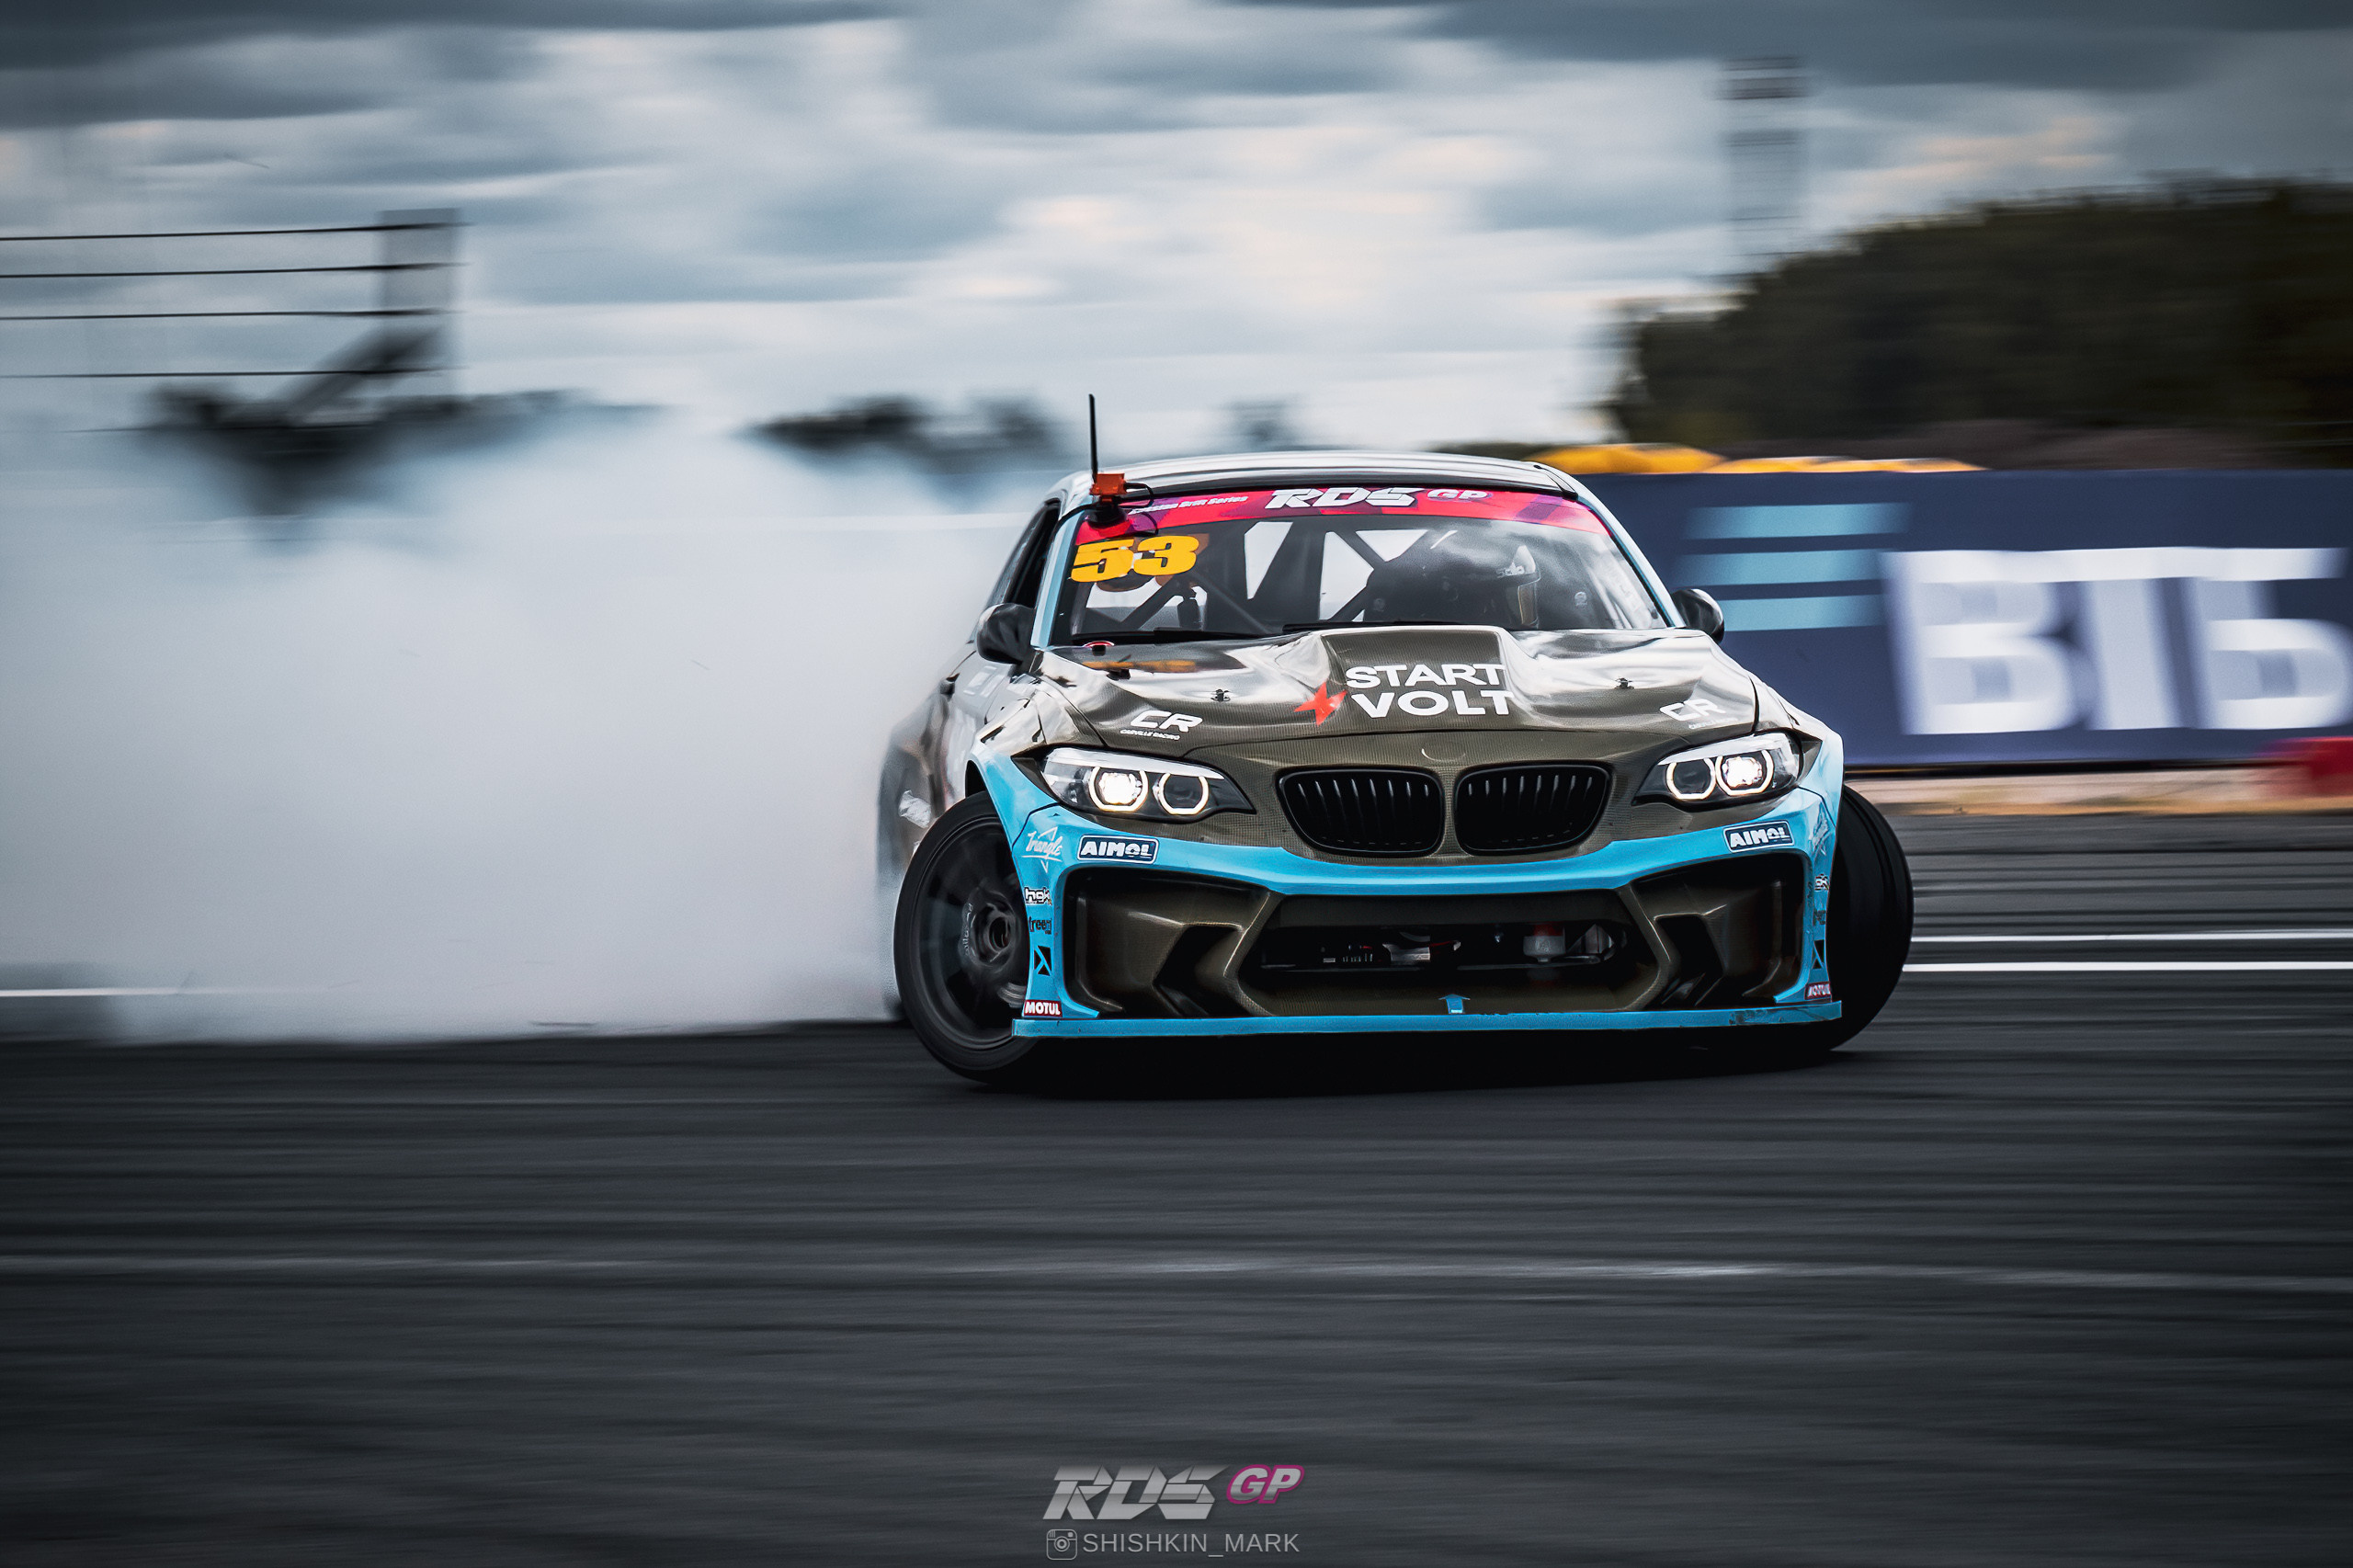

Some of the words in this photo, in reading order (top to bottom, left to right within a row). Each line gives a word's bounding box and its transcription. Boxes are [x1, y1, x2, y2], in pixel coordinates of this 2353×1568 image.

[1265, 486, 1426, 509] RDS
[1427, 489, 1491, 502] GP
[1071, 535, 1199, 583] 53
[1882, 547, 2353, 734] ВТБ
[1346, 664, 1506, 688] START
[1350, 690, 1515, 719] VOLT
[1659, 699, 1726, 721] CR
[1131, 710, 1203, 733] CR
[1730, 826, 1790, 848] AIMOL
[1080, 840, 1153, 858] AIMOL
[1025, 1001, 1061, 1016] MOTUL
